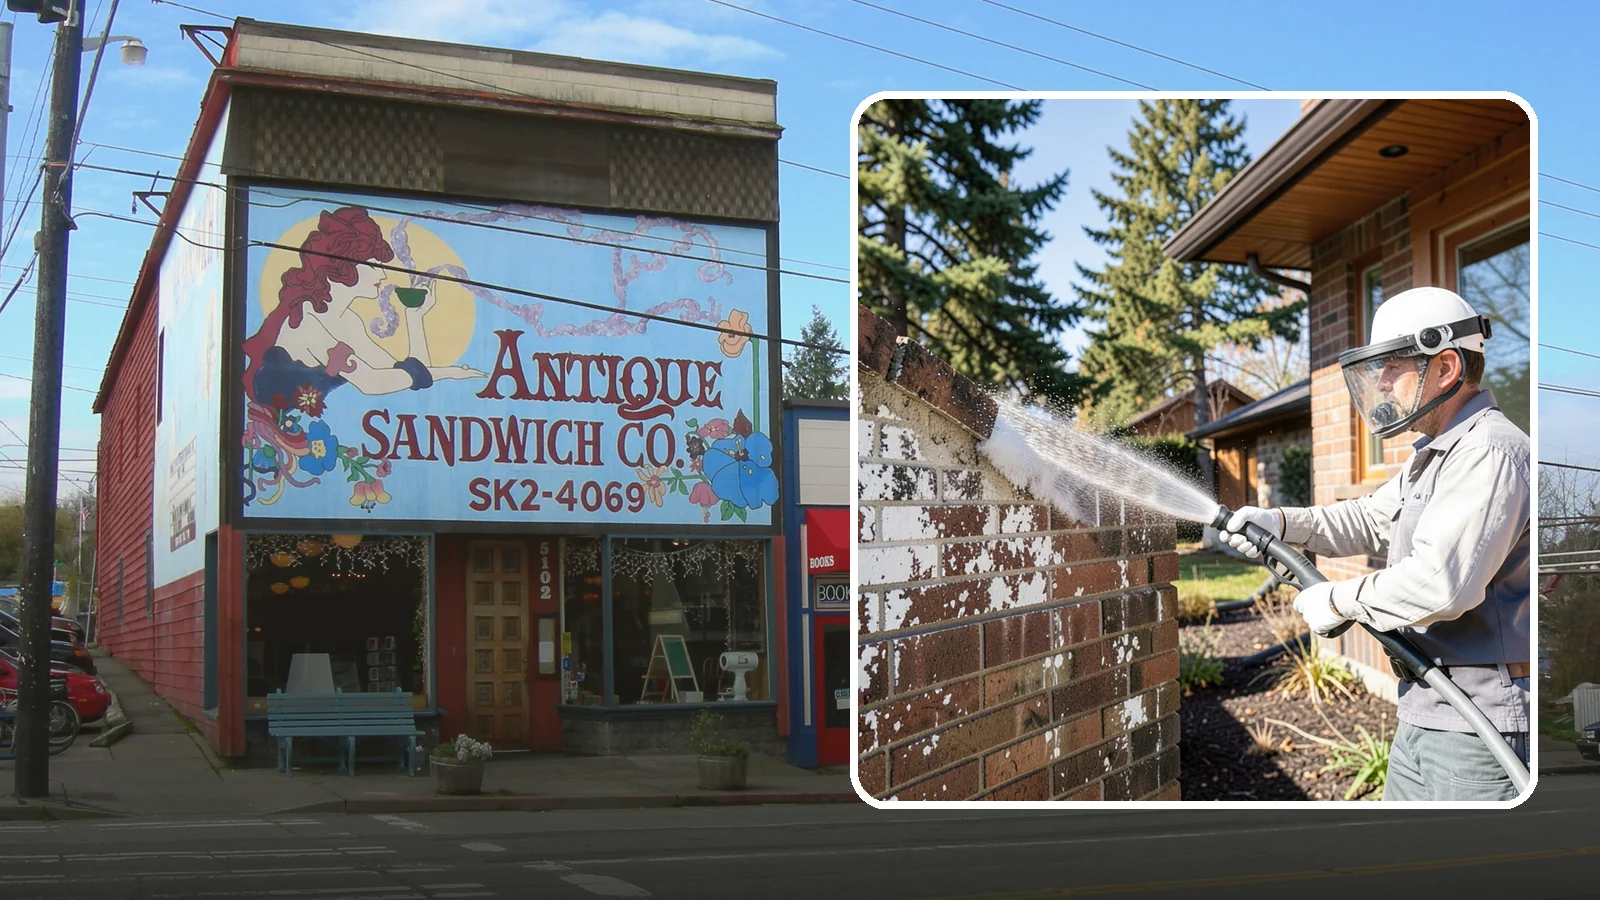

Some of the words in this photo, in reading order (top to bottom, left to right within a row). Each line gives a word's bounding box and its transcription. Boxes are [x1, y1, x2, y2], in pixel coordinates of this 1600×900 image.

[475, 329, 723, 421] ANTIQUE
[361, 408, 604, 467] SANDWICH
[617, 421, 685, 469] CO.
[468, 477, 646, 513] SK2-4069
[540, 542, 551, 599] 5102
[809, 555, 835, 569] BOOKS
